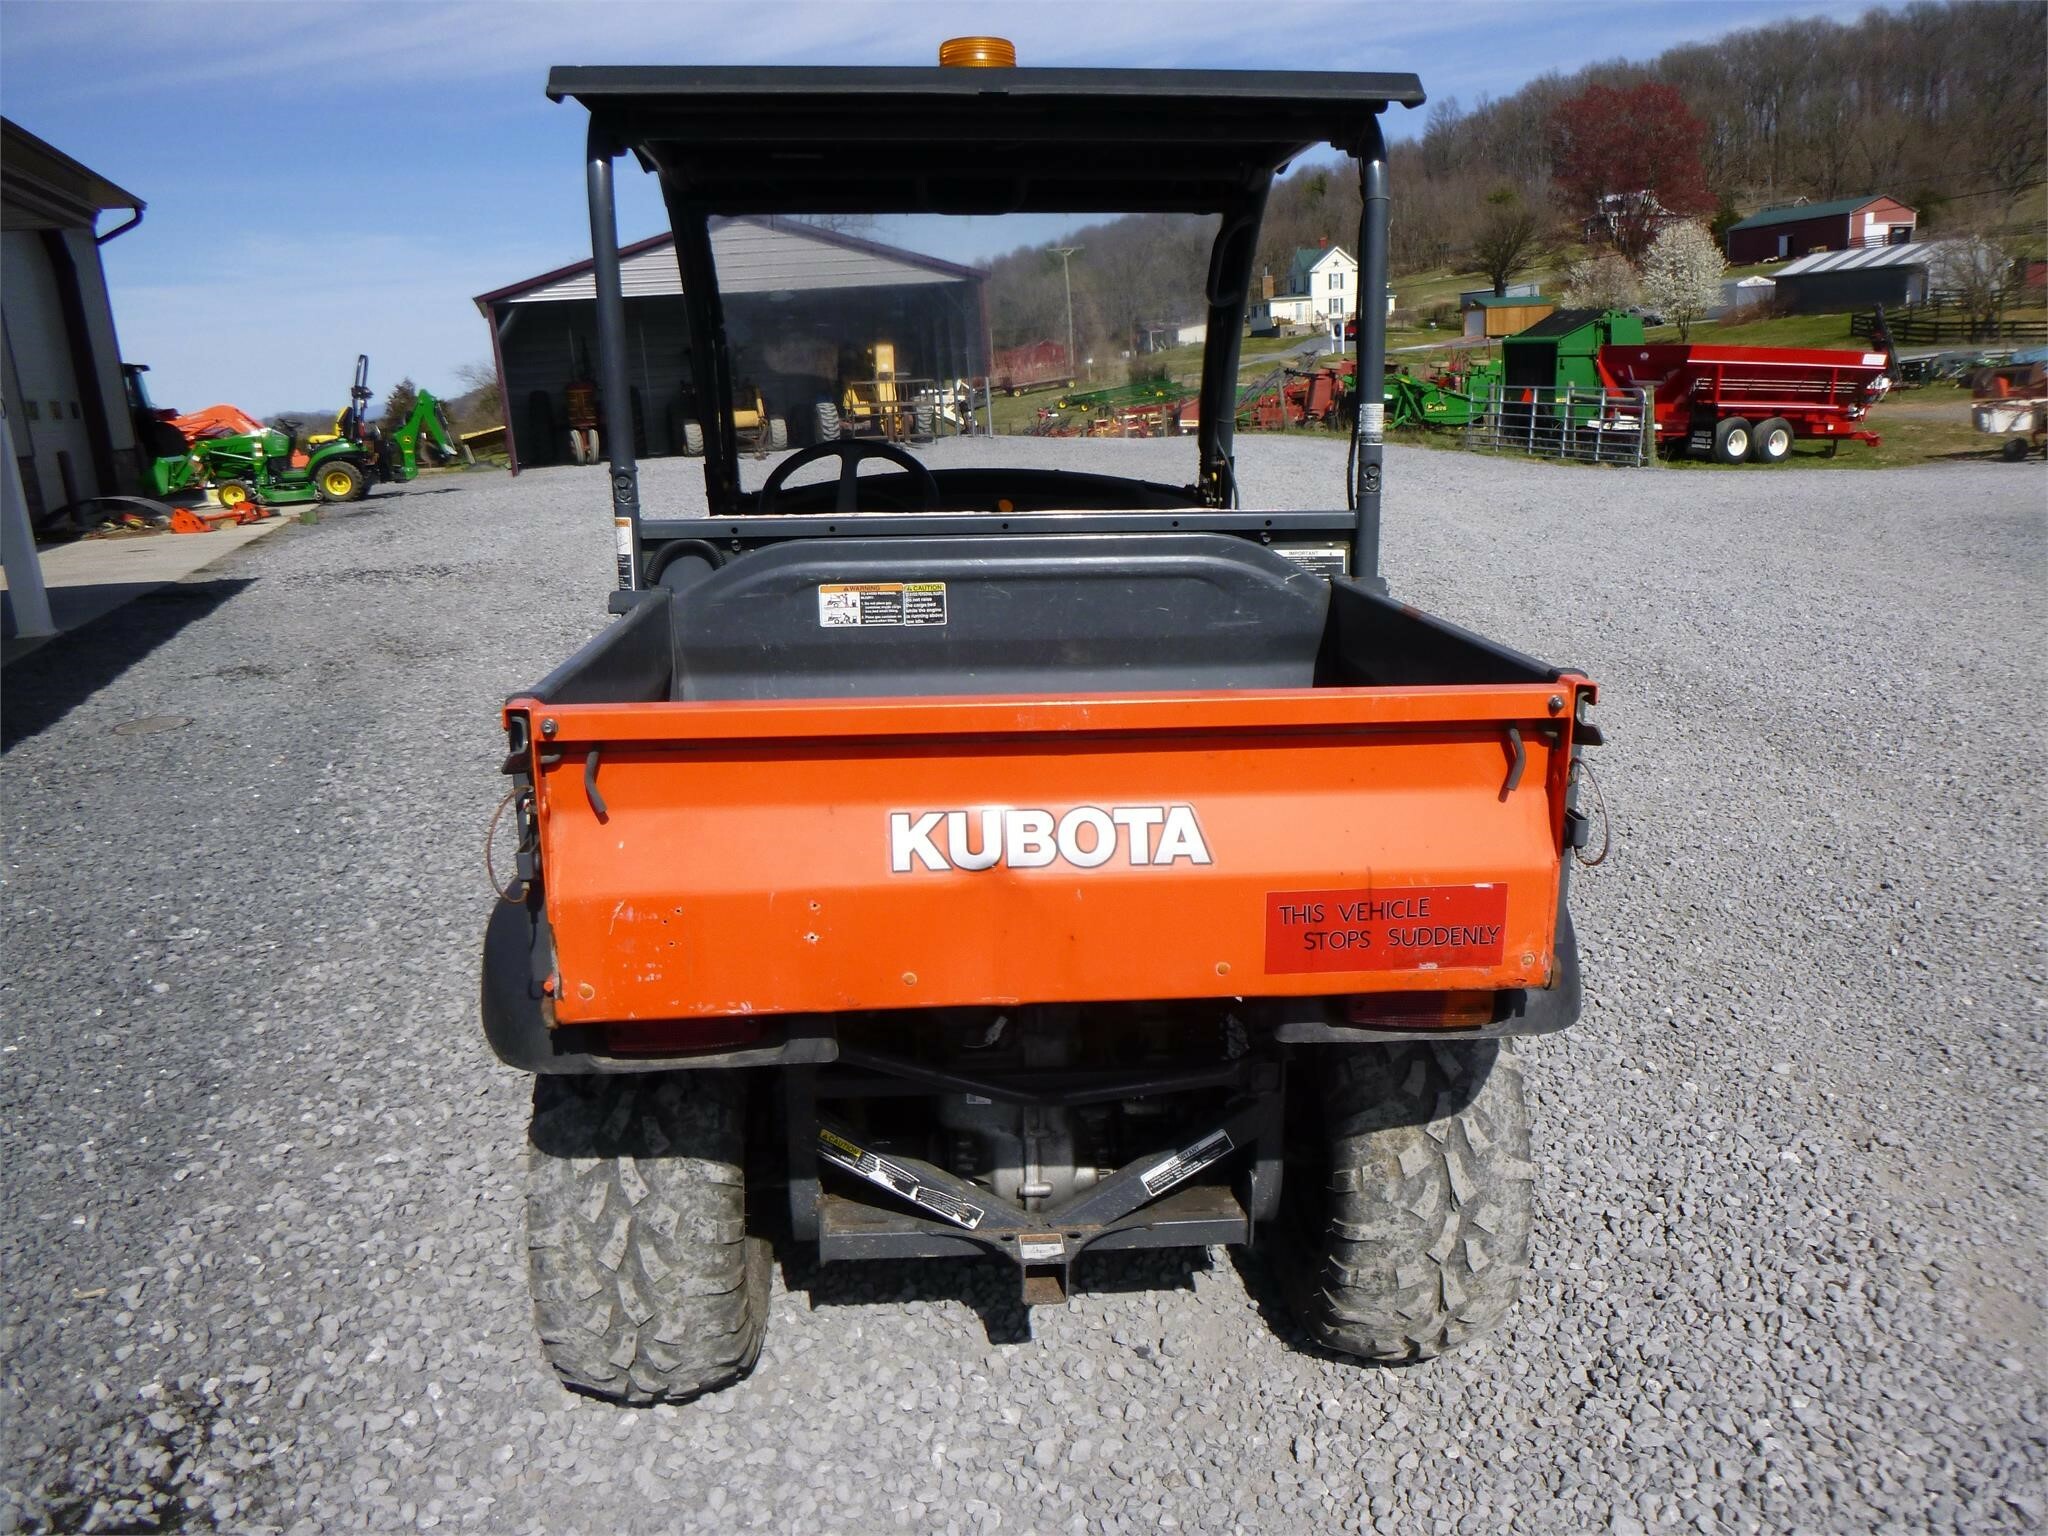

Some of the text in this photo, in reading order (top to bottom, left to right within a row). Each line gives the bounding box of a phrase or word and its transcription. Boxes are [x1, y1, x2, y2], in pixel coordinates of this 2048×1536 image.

[890, 806, 1212, 872] KUBOTA
[1279, 898, 1430, 925] THIS VEHICLE
[1303, 925, 1500, 951] STOPS SUDDENLY
[828, 1134, 860, 1156] CAUTION
